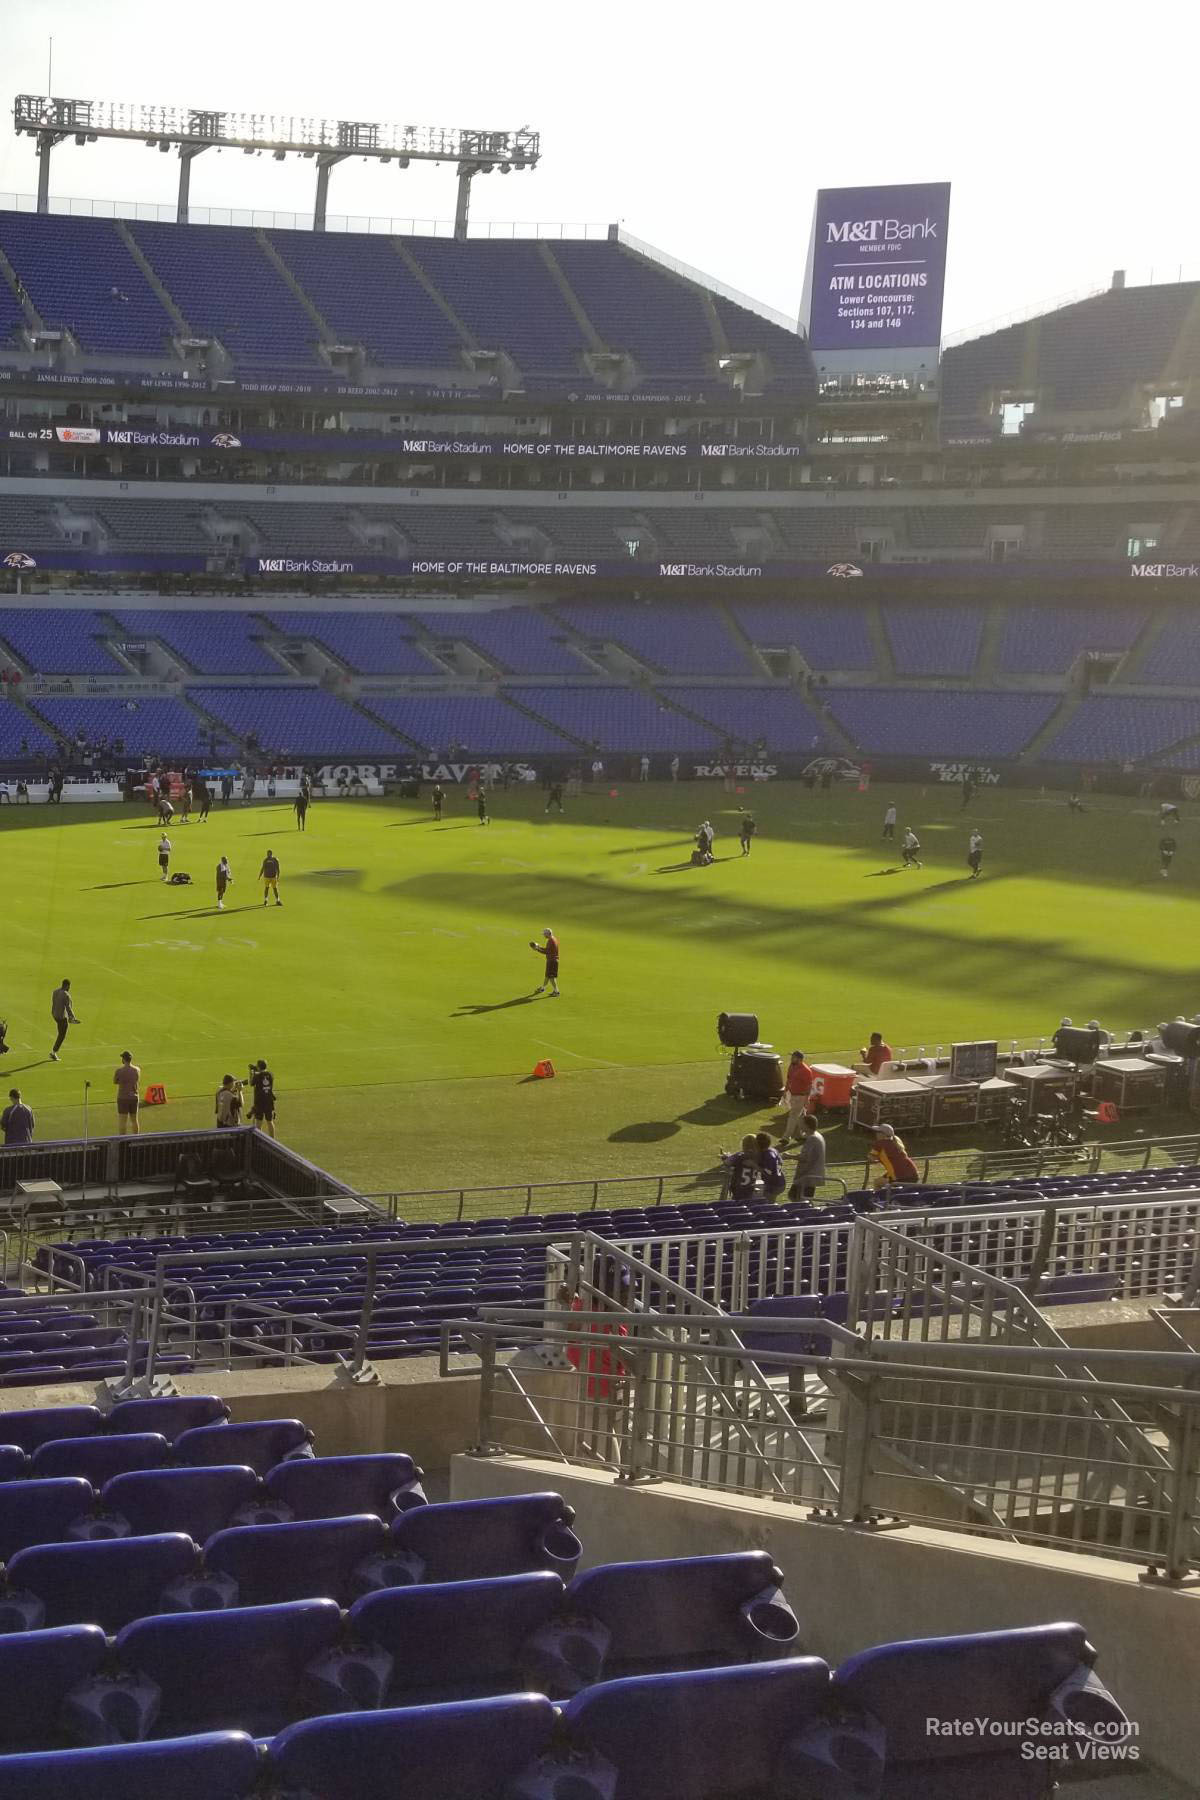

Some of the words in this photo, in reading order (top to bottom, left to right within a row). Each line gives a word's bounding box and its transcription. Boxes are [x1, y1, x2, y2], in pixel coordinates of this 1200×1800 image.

[826, 220, 883, 243] M&T
[884, 217, 937, 240] Bank
[859, 244, 886, 252] MEMBER
[887, 243, 902, 251] FDIC
[829, 275, 854, 290] ATM
[858, 273, 928, 290] LOCATIONS
[840, 295, 864, 305] Lower
[867, 293, 914, 303] Concourse:
[838, 307, 874, 318] Sections
[876, 306, 894, 318] 107,
[896, 304, 914, 316] 117,
[850, 320, 865, 329] 134
[868, 318, 884, 328] and
[886, 318, 901, 328] 146
[37, 374, 58, 382] JAMAL
[59, 375, 80, 384] LEWIS
[154, 380, 173, 388] LEWIS
[260, 384, 276, 392] HEAP
[40, 429, 52, 439] 25
[106, 430, 133, 443] M&T
[134, 432, 158, 444] Bank
[160, 432, 200, 446] Stadium
[402, 440, 427, 452] M&T
[428, 440, 452, 453] Bank
[452, 441, 492, 454] Stadium
[503, 444, 534, 454] HOME
[536, 444, 551, 454] OF
[554, 444, 575, 455] THE
[578, 444, 640, 456] BALTIMORE
[642, 444, 686, 456] RAVENS
[700, 444, 728, 456] M&T
[729, 444, 754, 456] Bank
[756, 444, 800, 456] Stadium
[258, 560, 285, 572] M&T
[286, 560, 311, 572] Bank
[312, 560, 353, 573] Stadium
[412, 562, 444, 573] HOME
[448, 562, 463, 574] OF
[466, 562, 488, 574] THE
[490, 563, 552, 574] BALTIMORE
[554, 564, 597, 574] RAVENS
[660, 564, 688, 576] M&T
[688, 564, 714, 576] Bank
[716, 564, 762, 576] Stadium
[1131, 564, 1166, 576] M&T
[1166, 564, 1199, 576] Bank
[413, 764, 530, 781] RAVNS
[151, 1086, 166, 1104] 20
